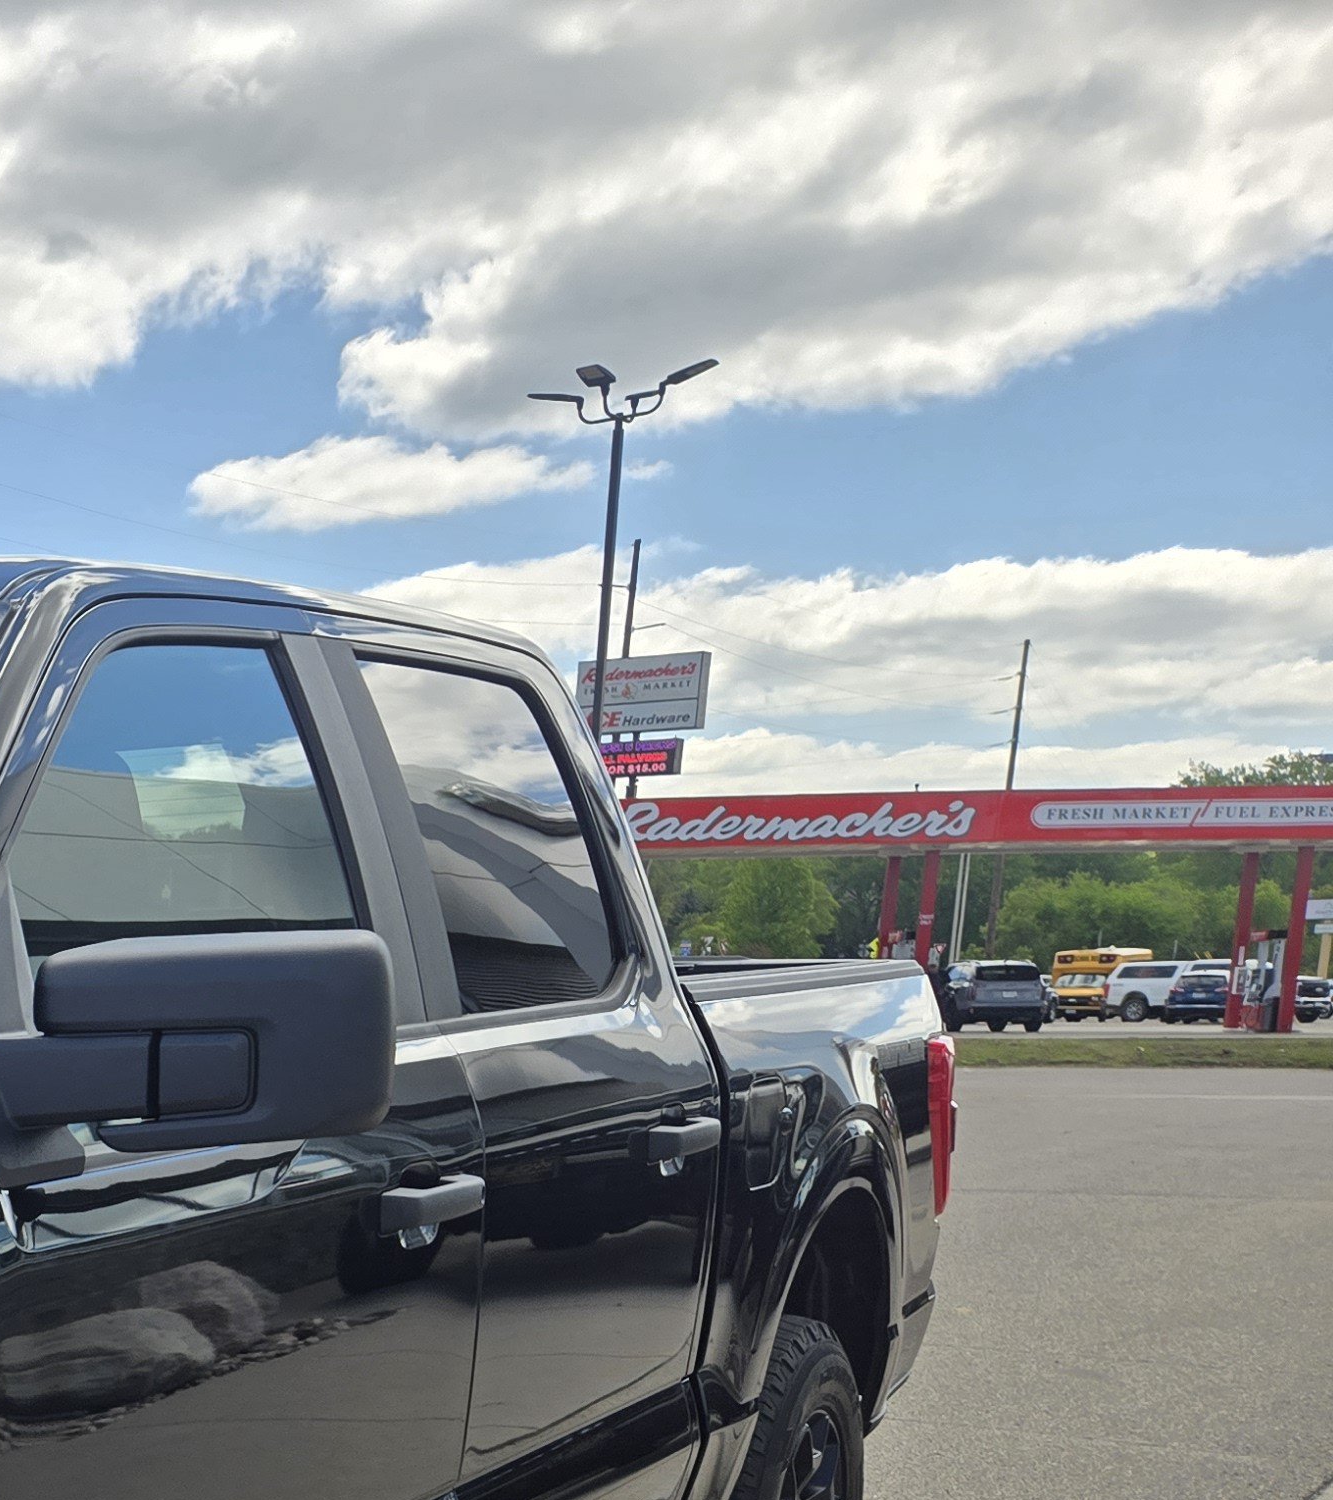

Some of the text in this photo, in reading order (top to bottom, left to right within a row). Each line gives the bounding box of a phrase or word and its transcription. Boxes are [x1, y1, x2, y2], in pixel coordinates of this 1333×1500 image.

[581, 662, 697, 684] Rdermacher's
[642, 680, 692, 691] MARKET
[622, 712, 691, 727] Hardware
[1046, 807, 1105, 820] FRESH
[1112, 806, 1192, 820] MARKET
[1214, 805, 1261, 819] FUEL
[625, 800, 977, 842] Radermacher's
